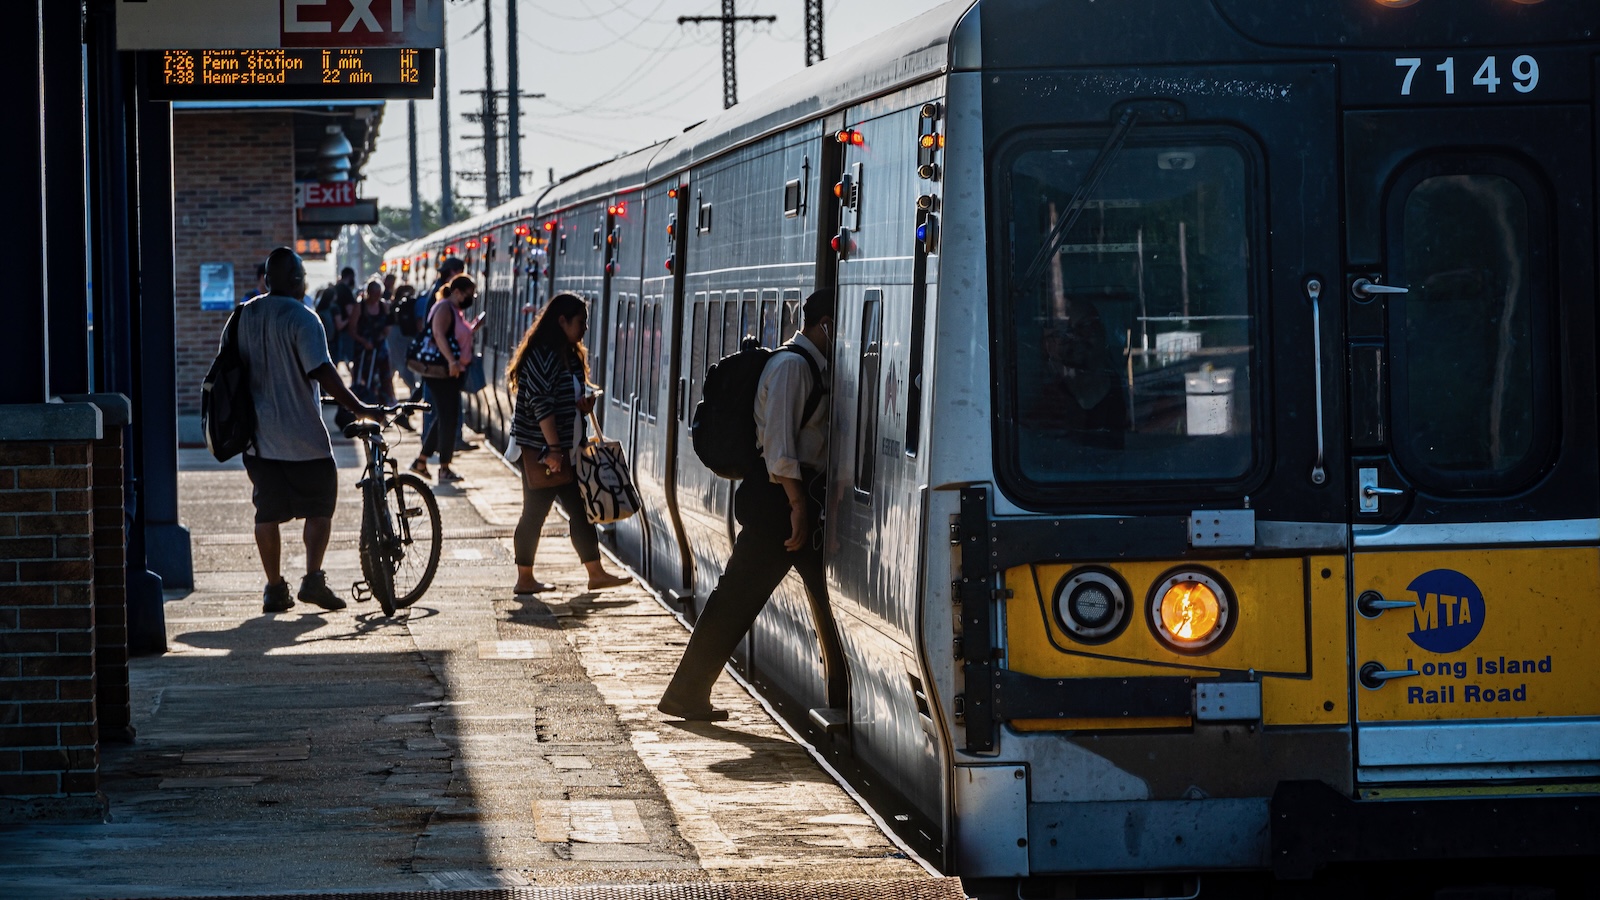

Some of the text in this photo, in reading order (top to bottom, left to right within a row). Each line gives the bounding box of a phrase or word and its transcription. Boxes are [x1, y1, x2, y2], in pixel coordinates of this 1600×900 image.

[163, 55, 194, 70] 7:26
[203, 55, 239, 70] Penn
[247, 55, 303, 70] Station
[338, 54, 362, 69] min
[163, 68, 419, 84] 7:38 Hempstead 22 min H2
[1395, 54, 1540, 96] 7149
[306, 183, 351, 203] Exit
[1413, 591, 1472, 633] MTA
[1407, 655, 1552, 680] Long Island
[1407, 684, 1527, 705] Rail Road
